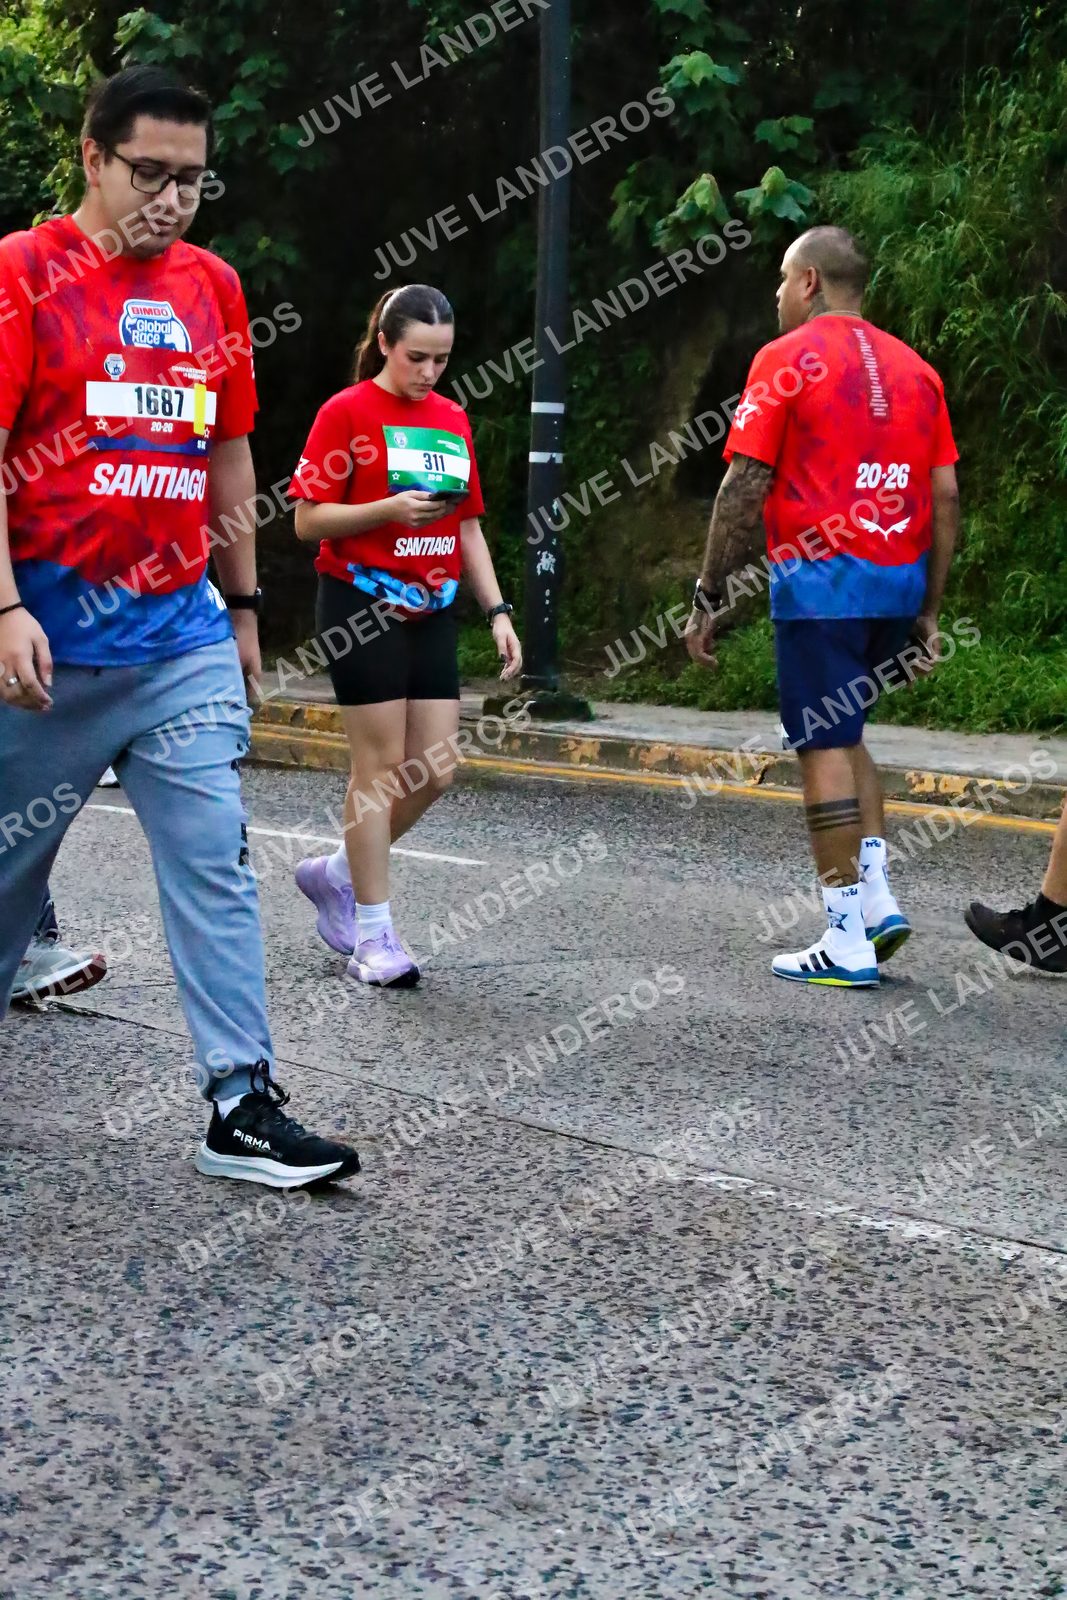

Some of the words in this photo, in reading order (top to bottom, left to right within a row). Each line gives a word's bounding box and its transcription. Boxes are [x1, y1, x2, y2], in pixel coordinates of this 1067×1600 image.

[131, 305, 169, 317] BIMBO
[131, 329, 161, 345] Race
[136, 319, 172, 334] Global
[134, 386, 184, 417] 1687
[423, 452, 445, 472] 311
[88, 462, 207, 502] SANTIAGO
[393, 535, 456, 557] SANTIAGO
[232, 1128, 272, 1151] PIRMA
